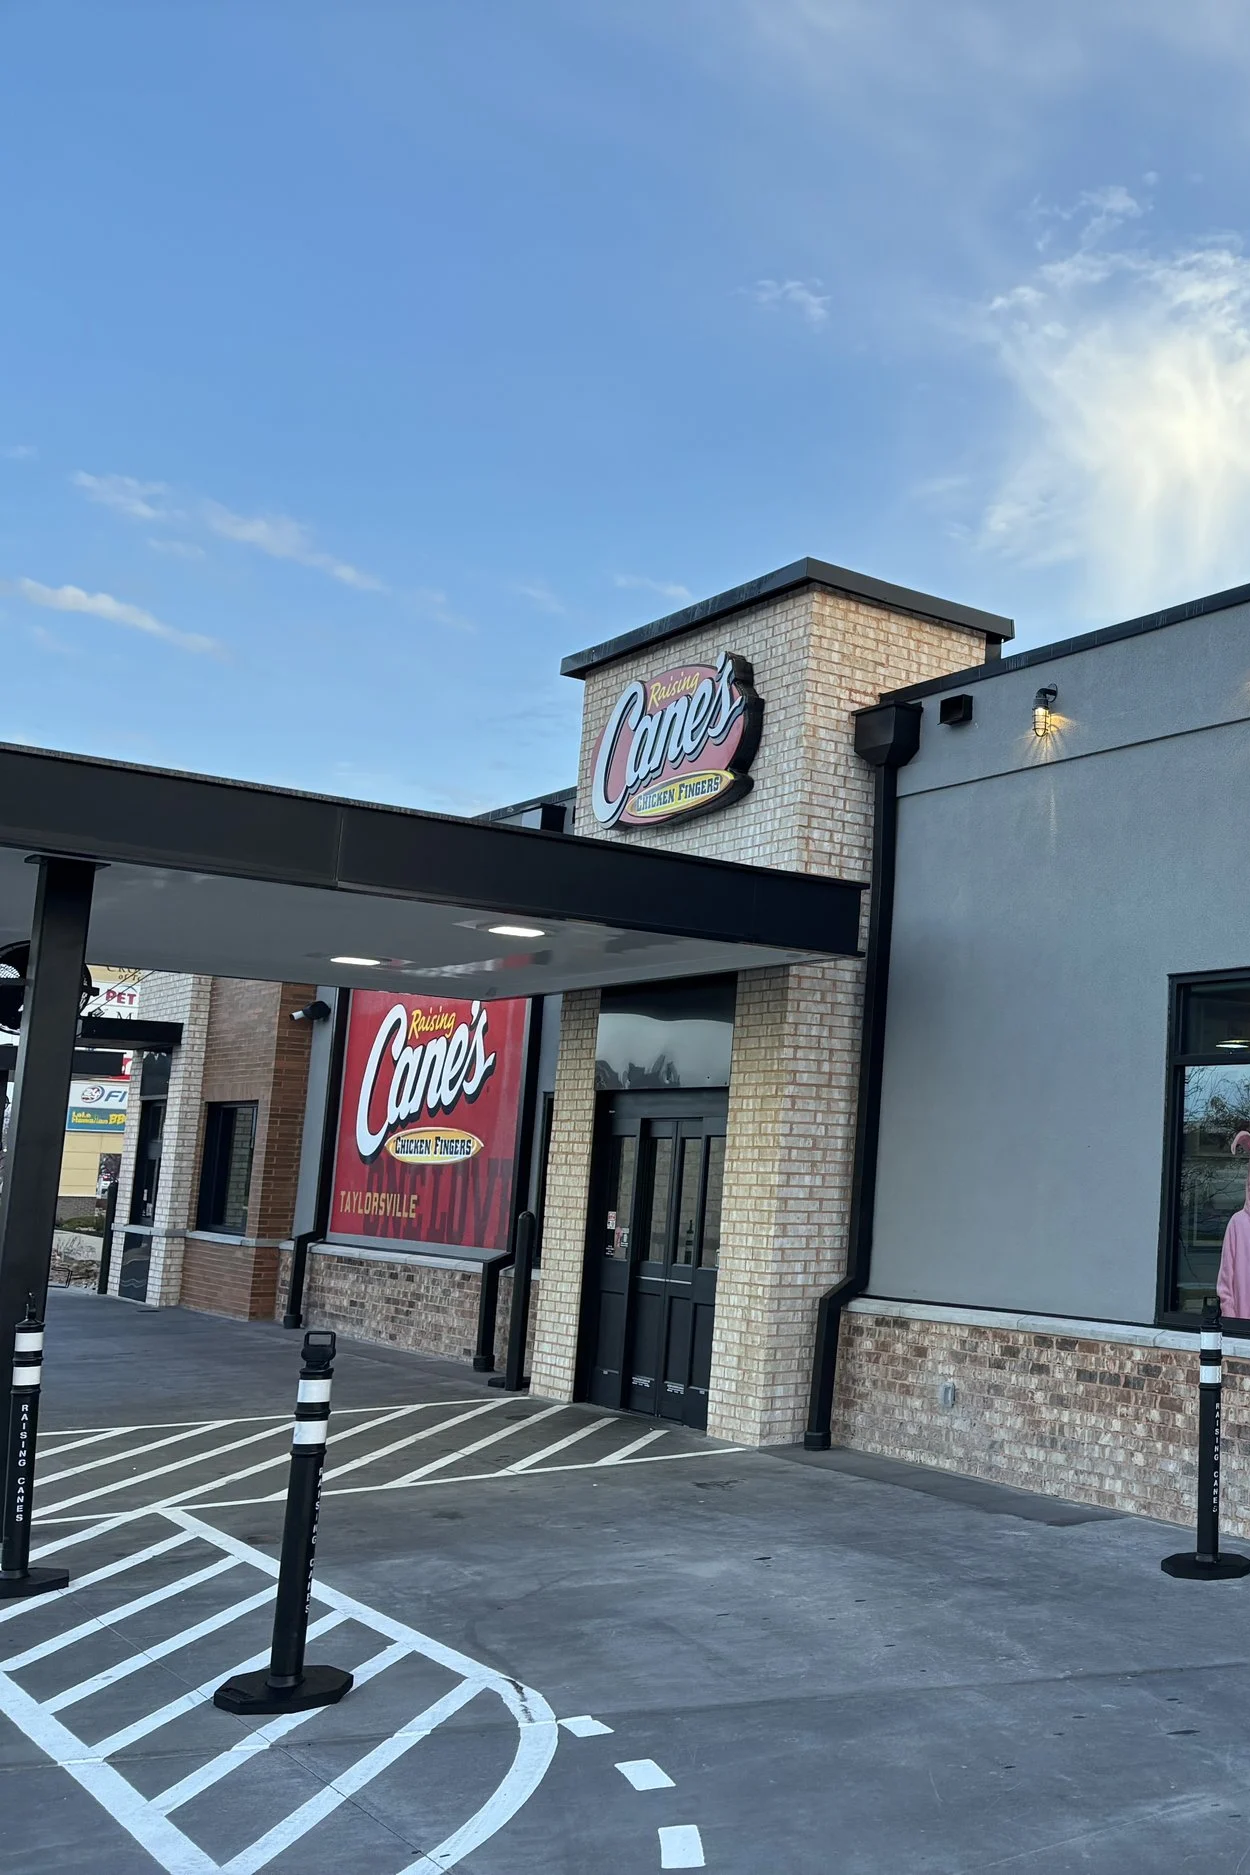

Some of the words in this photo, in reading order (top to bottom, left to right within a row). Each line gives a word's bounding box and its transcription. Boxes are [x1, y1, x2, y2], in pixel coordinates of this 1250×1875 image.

[648, 672, 700, 711] Raising
[592, 651, 744, 826] Cane's
[636, 788, 675, 812] CHICKEN
[678, 776, 720, 797] FINGERS
[105, 989, 137, 1006] PET
[408, 1006, 457, 1039] Raising
[356, 1000, 496, 1160] Cane's
[109, 1113, 128, 1125] BB
[394, 1136, 432, 1155] CHICKEN
[433, 1136, 473, 1156] FINGERS
[340, 1190, 418, 1219] TAYLORSVILLE
[18, 1404, 29, 1467] RAISING
[15, 1477, 26, 1522] CANES
